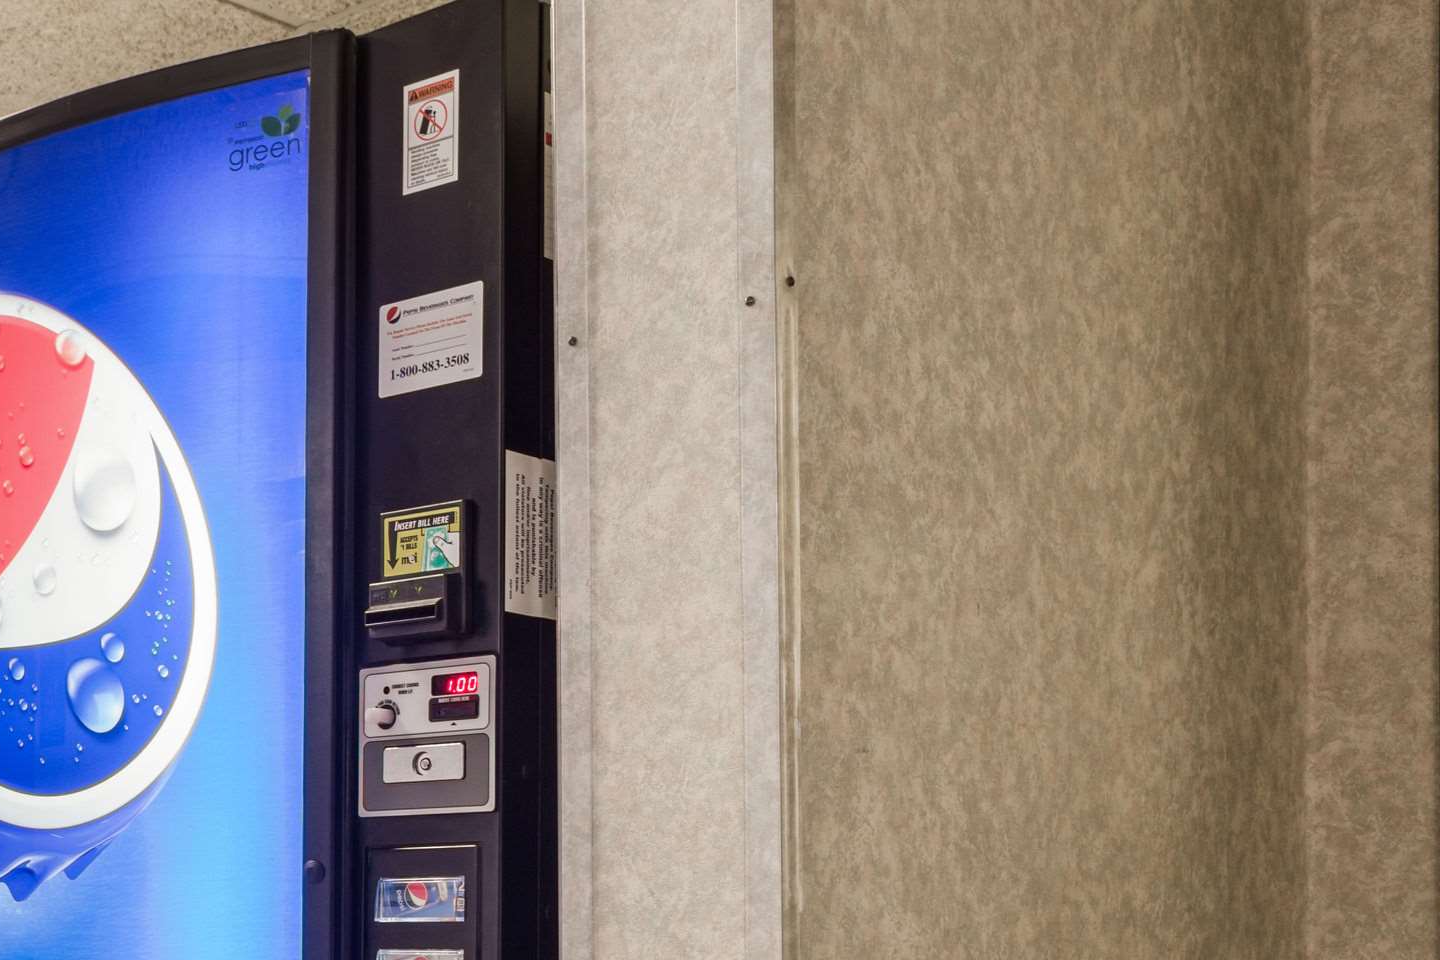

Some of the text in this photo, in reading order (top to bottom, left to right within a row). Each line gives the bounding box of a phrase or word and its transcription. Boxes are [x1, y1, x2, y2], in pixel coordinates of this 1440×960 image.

[418, 80, 454, 98] WARNING
[229, 137, 301, 172] green
[391, 352, 470, 381] 1-800-883-3508
[394, 515, 450, 532] INSERT BILL HERE
[448, 676, 477, 693] 1.00
